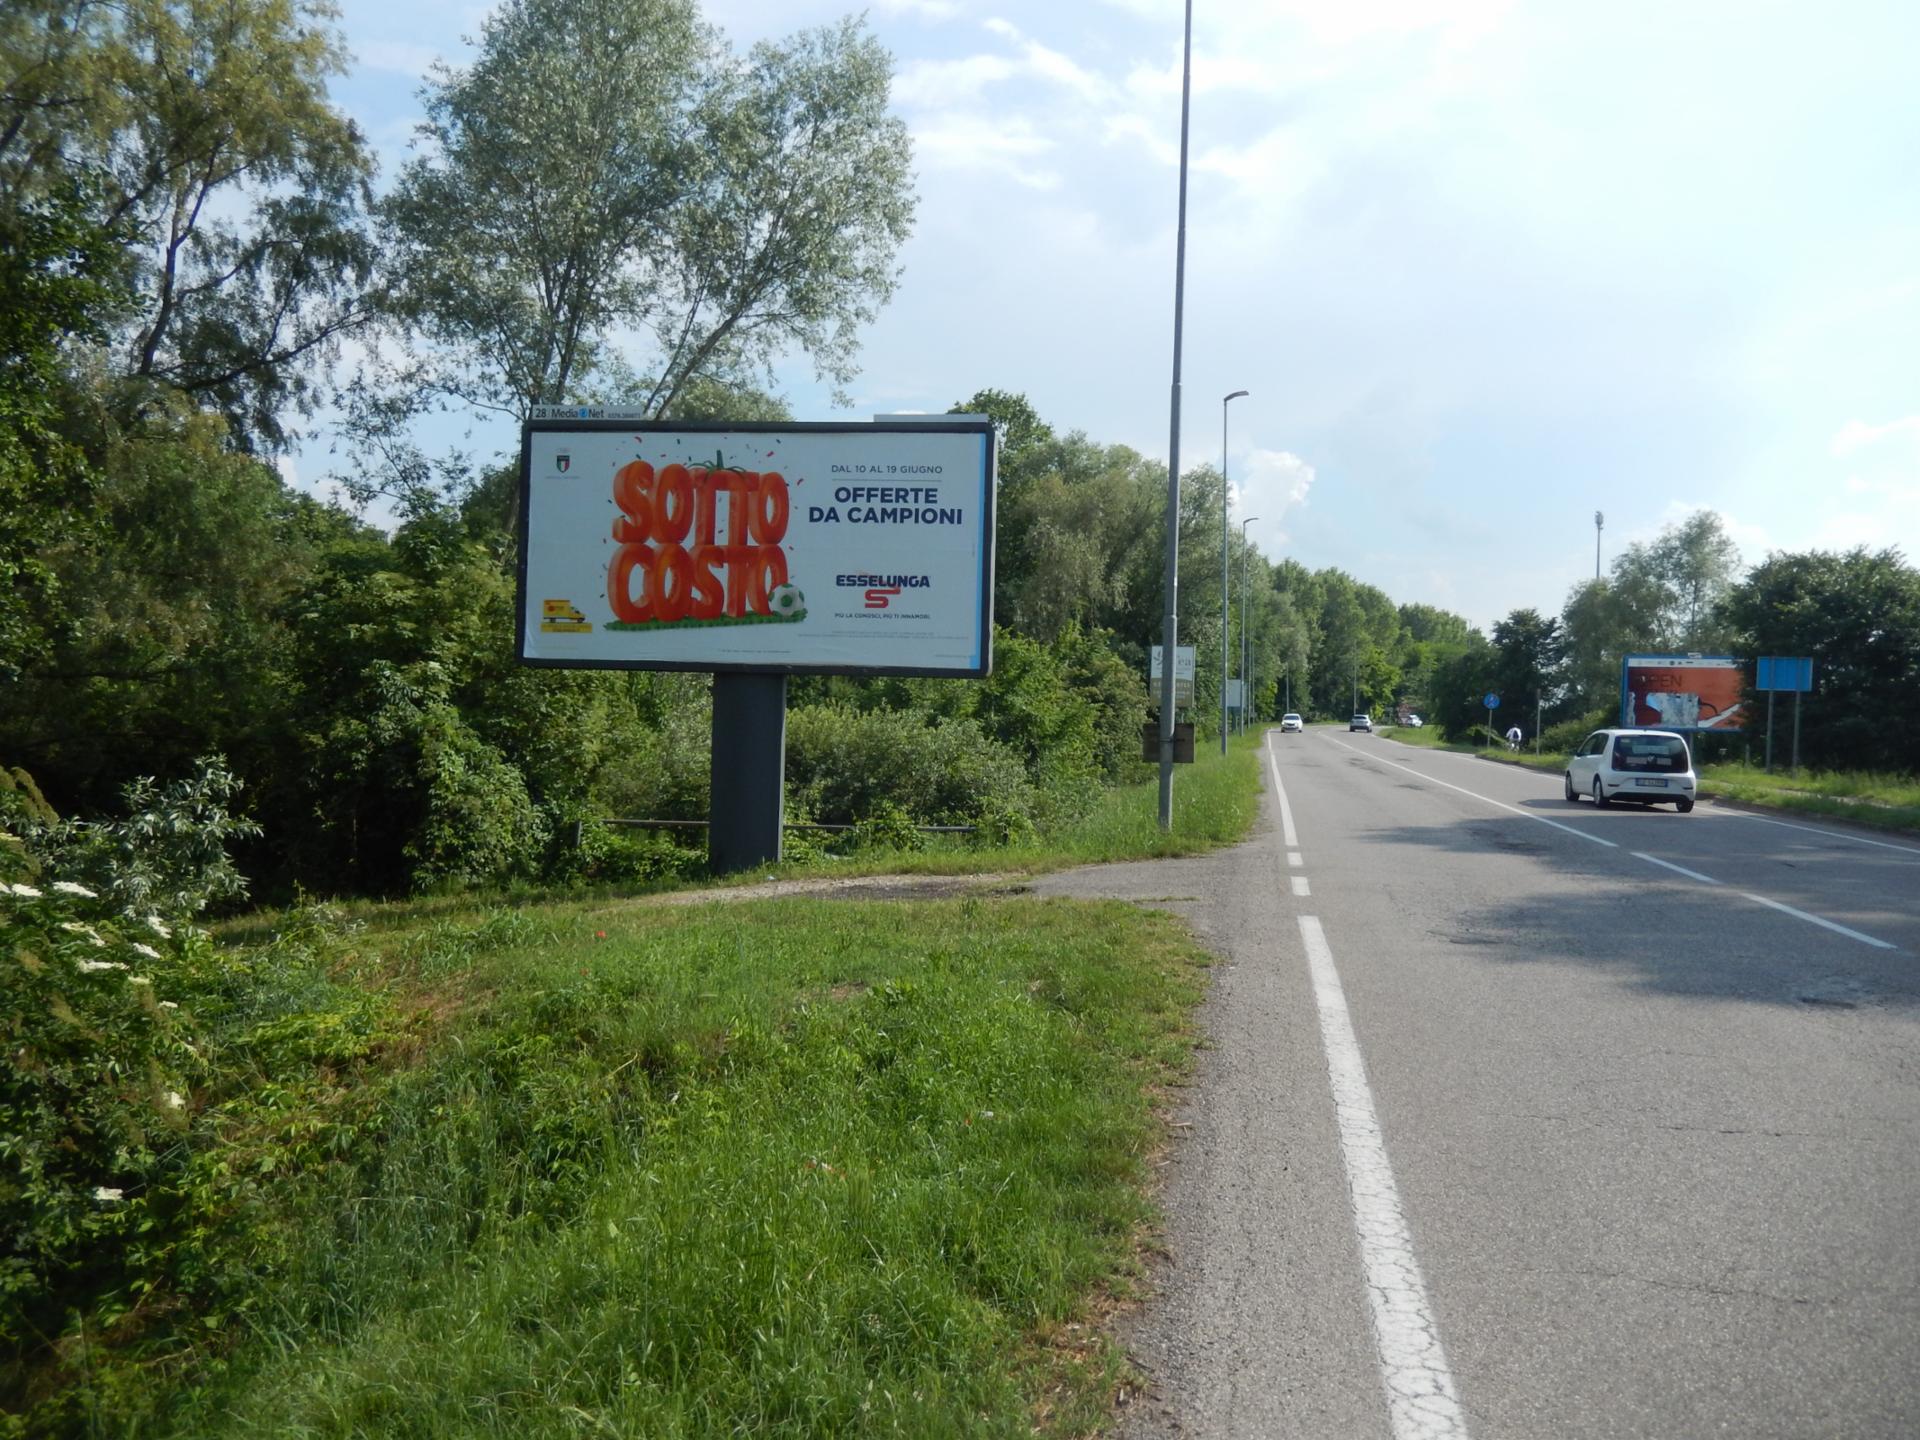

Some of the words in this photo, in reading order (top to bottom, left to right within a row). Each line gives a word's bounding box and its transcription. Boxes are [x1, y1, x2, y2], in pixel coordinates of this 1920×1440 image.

[535, 408, 547, 418] 28
[831, 464, 850, 473] DAL
[855, 465, 866, 473] 10
[870, 465, 883, 473] AL
[887, 465, 897, 473] 19
[900, 465, 943, 474] GIUGNO
[612, 460, 790, 546] SOTTO
[834, 486, 938, 504] OFFERTE
[809, 506, 840, 523] DA
[847, 506, 962, 525] CAMPIONI
[607, 543, 789, 624] COSTO
[836, 574, 930, 588] ESSELUNGA
